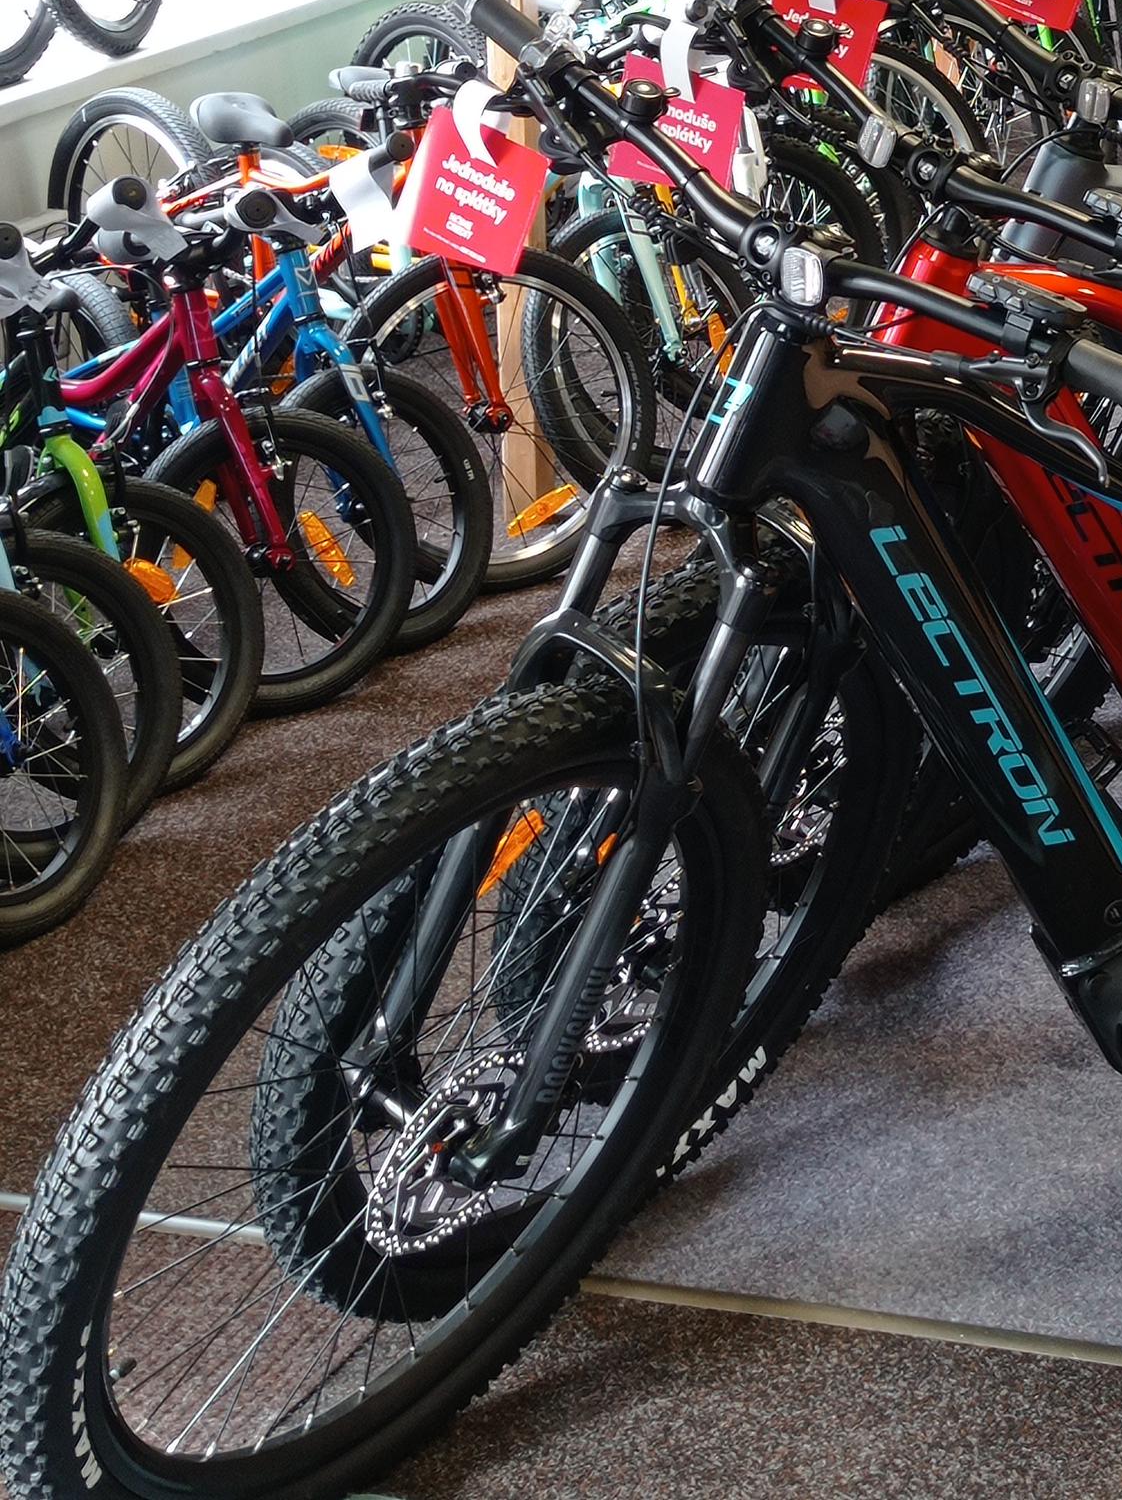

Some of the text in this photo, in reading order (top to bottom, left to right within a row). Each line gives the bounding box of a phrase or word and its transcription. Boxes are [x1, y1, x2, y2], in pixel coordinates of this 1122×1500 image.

[661, 121, 713, 154] splátky
[435, 176, 507, 226] na splátky
[442, 154, 516, 202] Jednoduše
[869, 524, 1076, 846] LECTRON
